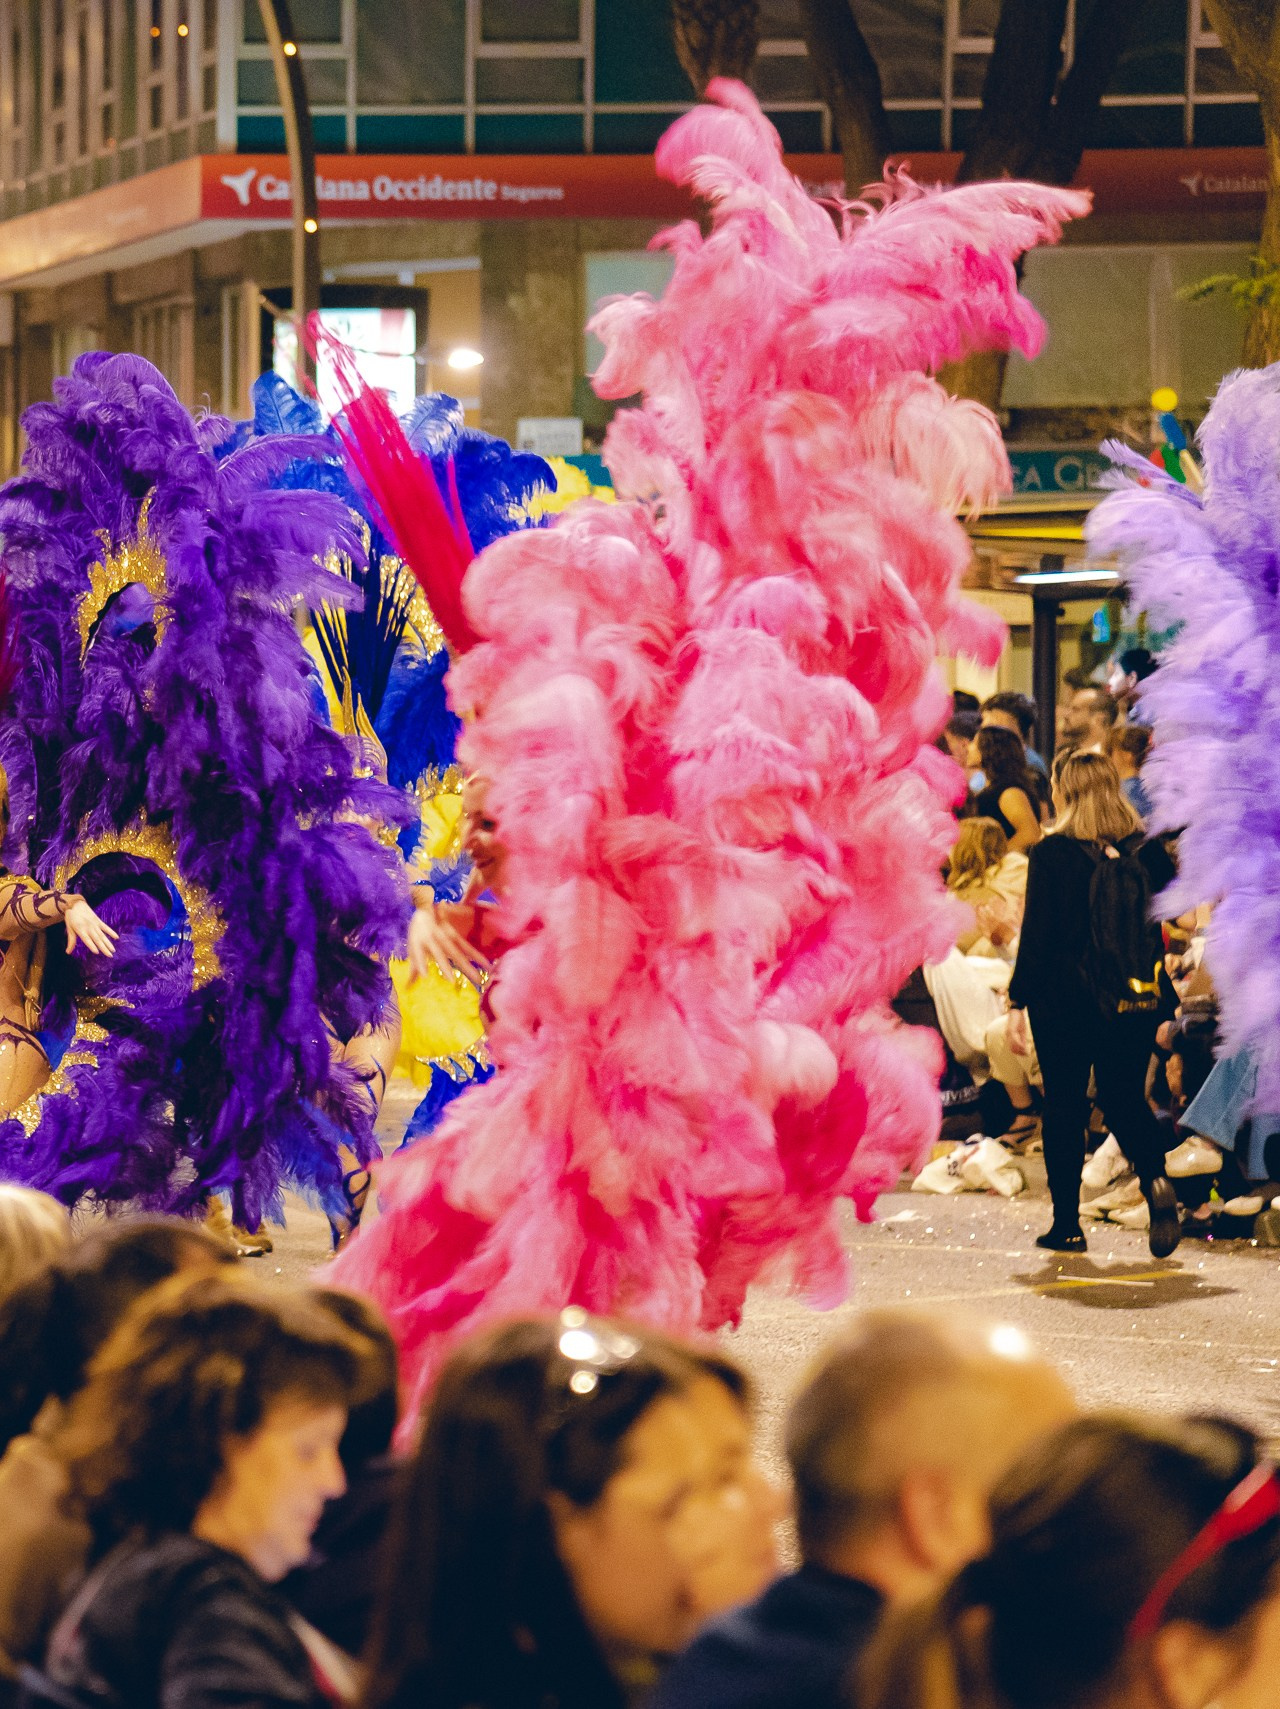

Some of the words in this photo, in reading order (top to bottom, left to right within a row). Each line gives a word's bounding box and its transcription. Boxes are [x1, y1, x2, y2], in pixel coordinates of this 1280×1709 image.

[257, 174, 371, 201] Calana
[372, 174, 498, 201] Occidente
[1203, 174, 1268, 193] Catalan
